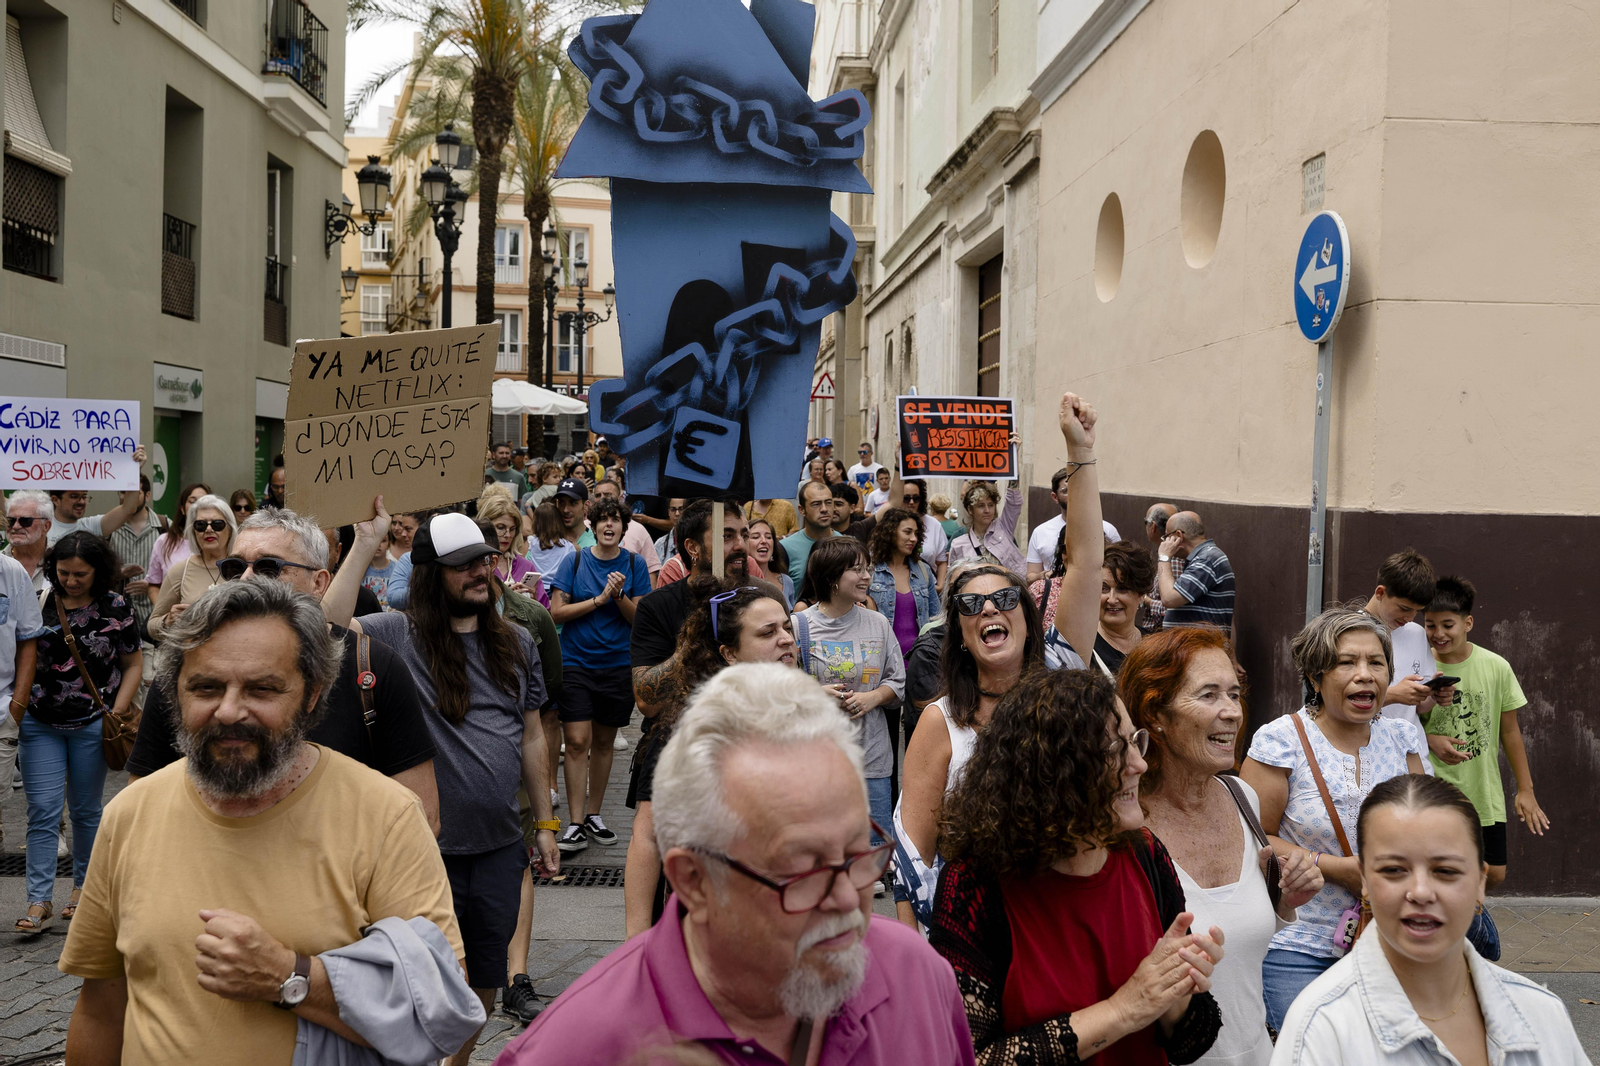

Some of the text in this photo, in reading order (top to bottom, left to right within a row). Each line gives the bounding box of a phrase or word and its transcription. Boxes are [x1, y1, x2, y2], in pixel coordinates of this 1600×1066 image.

[308, 332, 485, 380] YA ME QUITÉ
[72, 408, 132, 431] PARA
[903, 402, 1009, 426] SE VENDE
[296, 403, 480, 455] ¿DÓNDE ESTÁ
[927, 427, 1008, 449] RESISTENCIA
[88, 436, 137, 454] PARA
[12, 459, 116, 482] SOBREVIVIR
[314, 440, 455, 484] MI CASA?
[946, 452, 1007, 470] EXILIO
